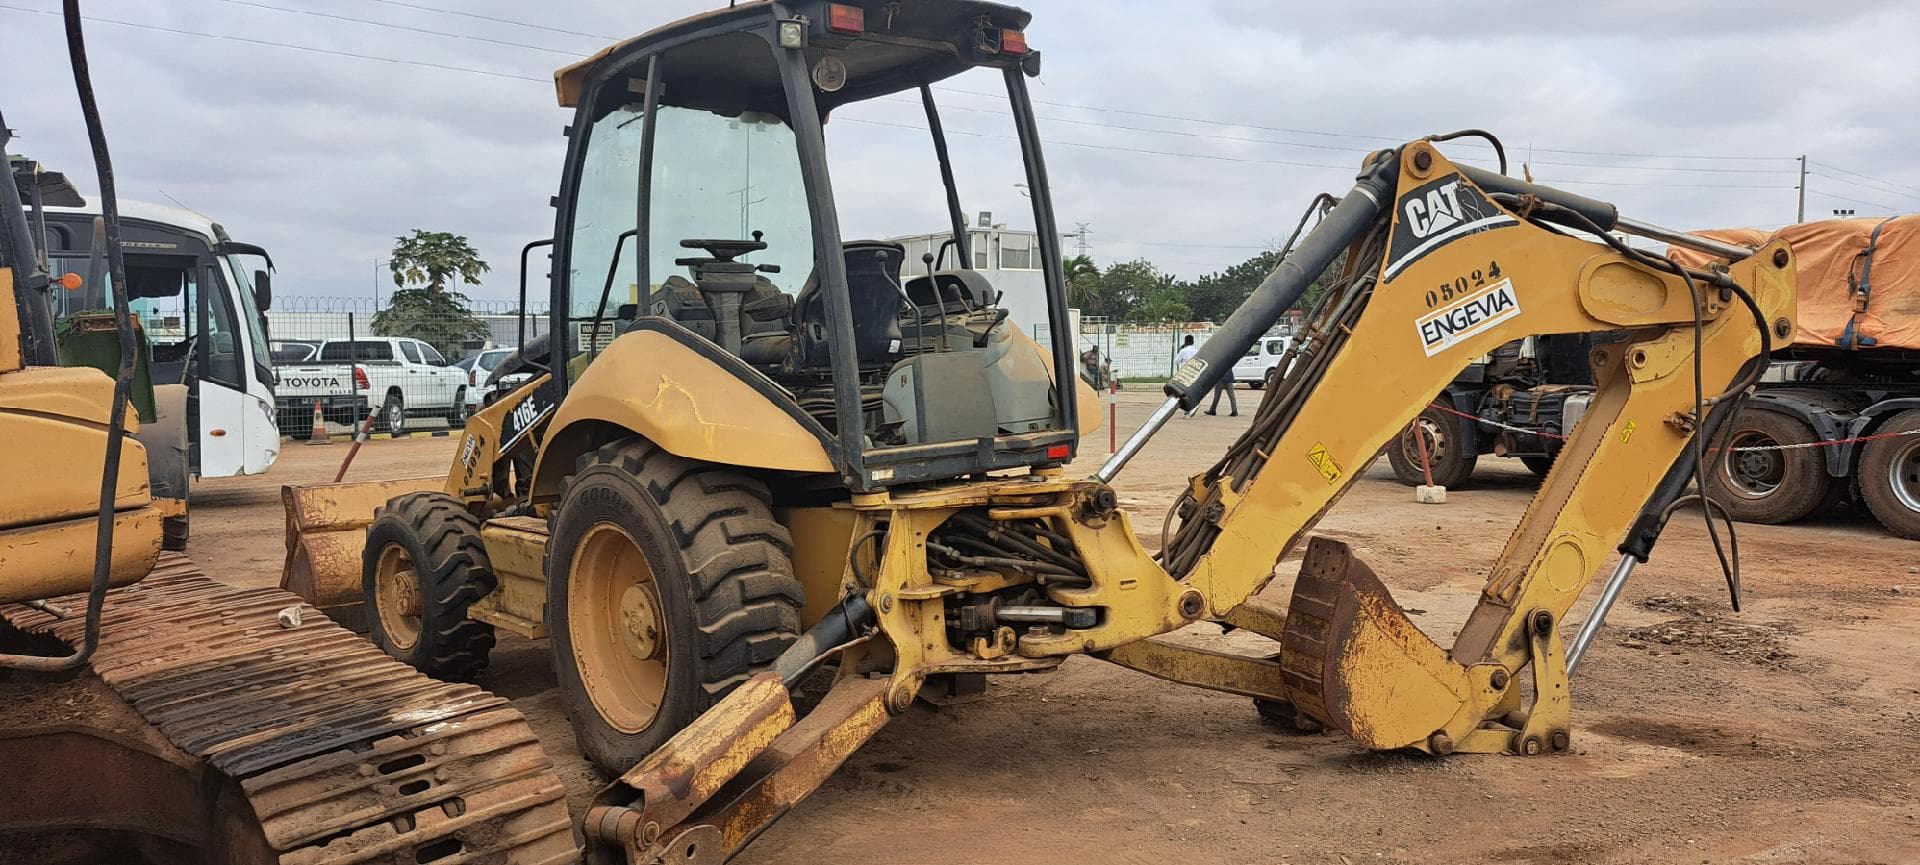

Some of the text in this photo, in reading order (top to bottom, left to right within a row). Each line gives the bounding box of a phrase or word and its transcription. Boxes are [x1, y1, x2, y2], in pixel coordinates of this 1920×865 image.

[1405, 179, 1464, 238] CAT
[1425, 261, 1501, 308] 05024
[1421, 288, 1514, 345] ENGEVIA
[283, 377, 340, 388] TOYOTA
[513, 395, 538, 432] 416E
